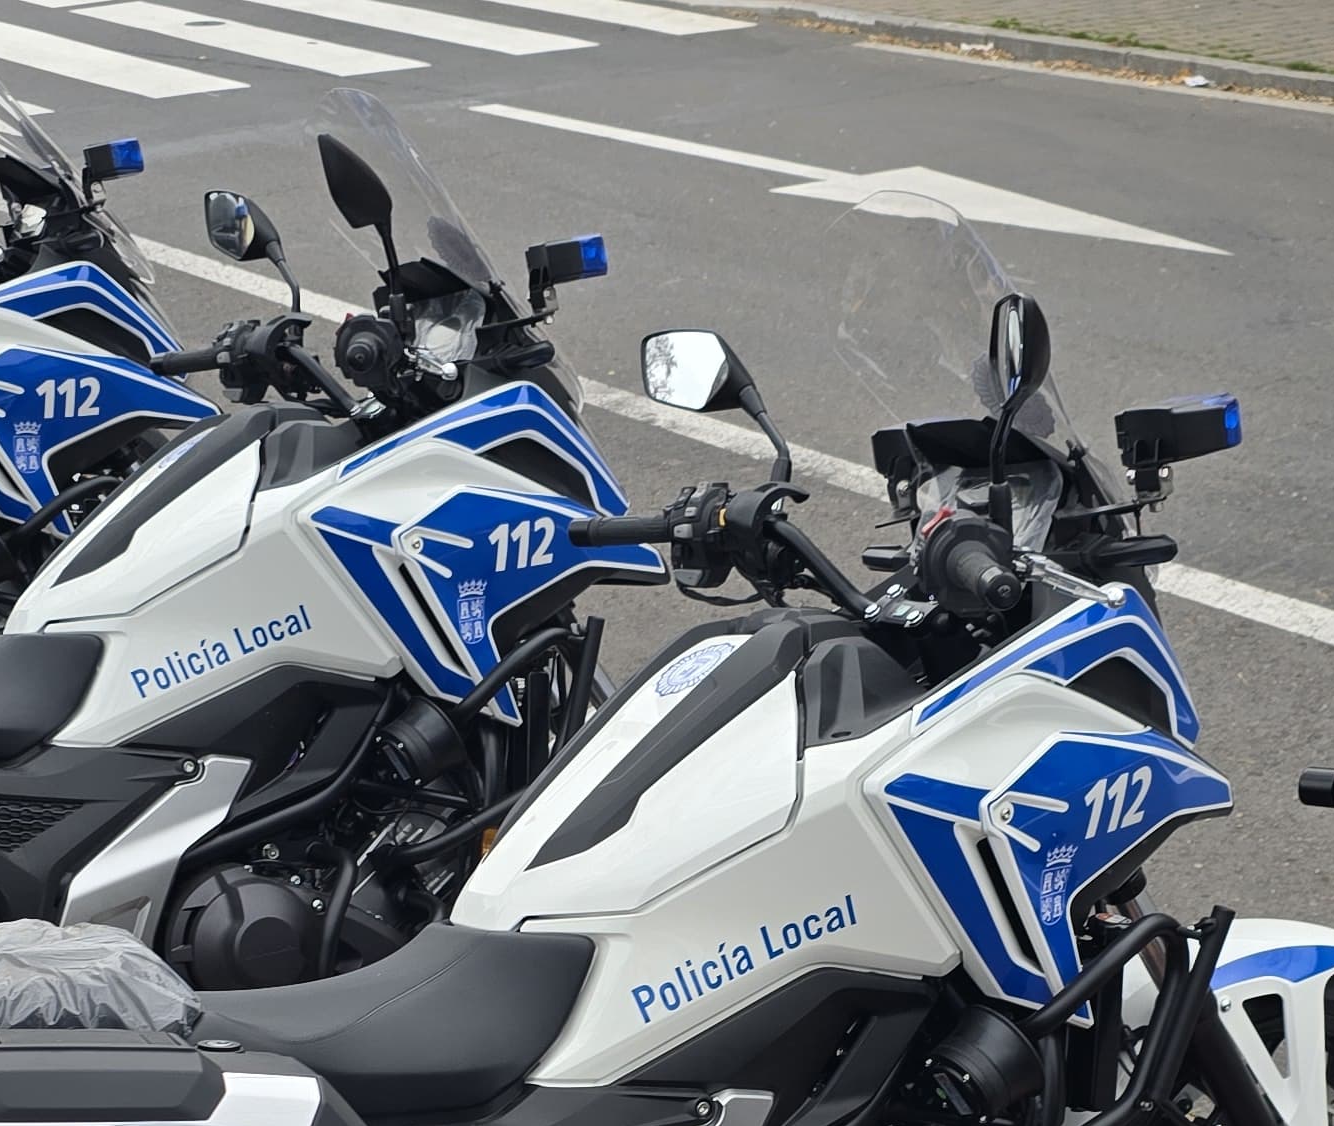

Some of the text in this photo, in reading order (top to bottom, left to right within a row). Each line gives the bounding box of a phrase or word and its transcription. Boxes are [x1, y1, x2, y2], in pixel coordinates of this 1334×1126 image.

[36, 375, 101, 420] 112
[487, 516, 556, 573] 112
[130, 604, 312, 699] Policía Local
[1083, 765, 1153, 840] 112
[630, 894, 858, 1024] Policía Local
